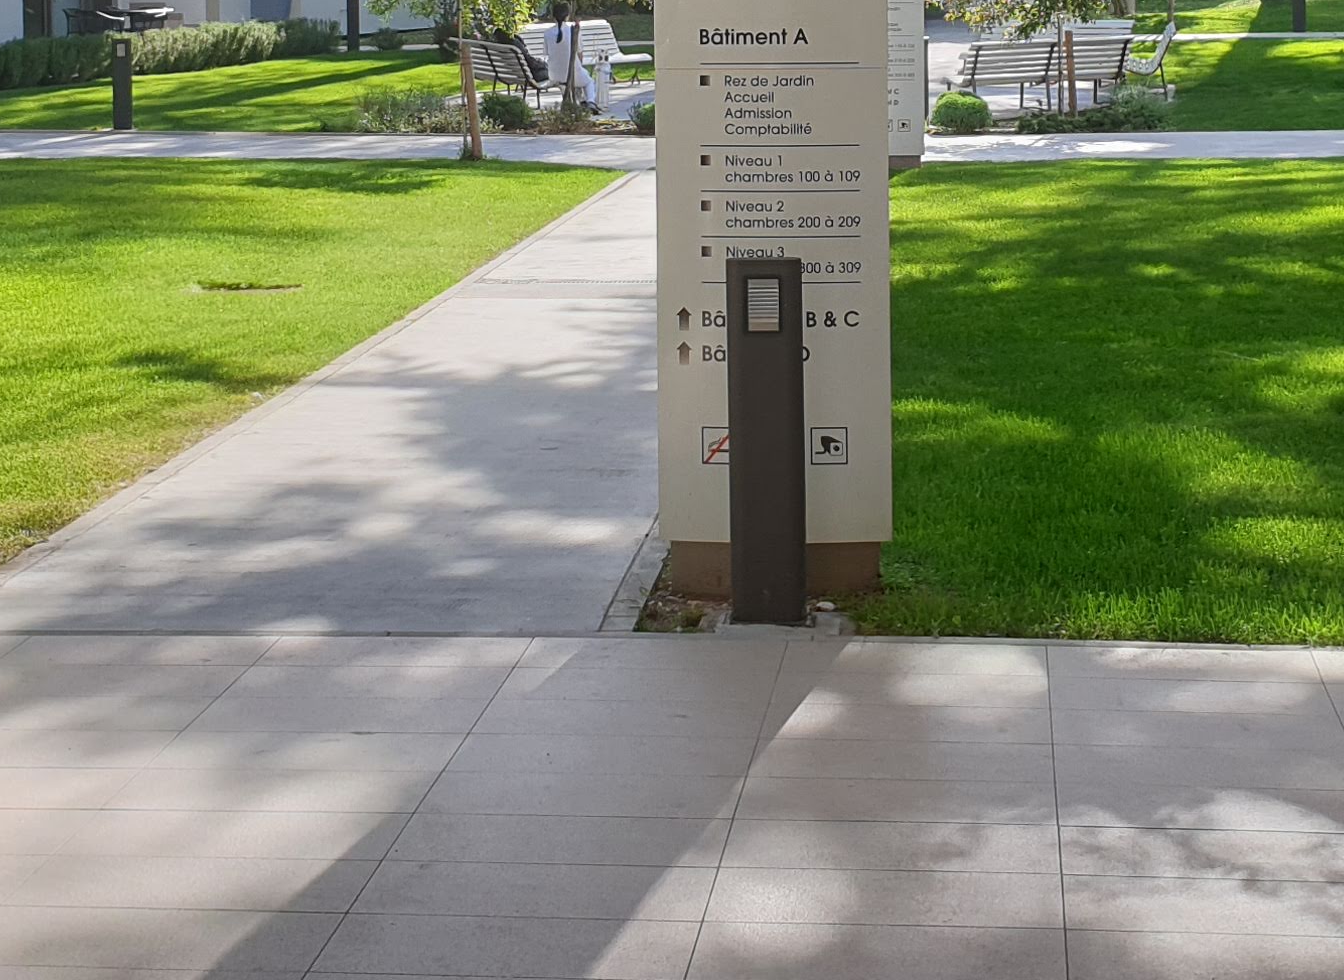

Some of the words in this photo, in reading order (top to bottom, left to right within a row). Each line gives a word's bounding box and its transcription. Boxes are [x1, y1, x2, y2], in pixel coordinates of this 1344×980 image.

[699, 27, 788, 46] Bâtiment
[793, 28, 809, 45] A
[725, 75, 747, 87] Rez
[750, 75, 769, 87] de
[772, 74, 815, 87] Jardin
[724, 91, 775, 103] Accueil
[724, 107, 793, 119] Admission
[724, 122, 812, 137] Comptabilité
[725, 155, 773, 167] Niveau
[777, 155, 782, 167] 1
[725, 171, 794, 183] chambres
[798, 171, 820, 182] 100
[824, 170, 834, 182] à
[838, 171, 861, 182] 109
[725, 201, 773, 213] Niveau
[776, 201, 785, 213] 2
[725, 217, 795, 229] chambres
[797, 217, 821, 229] 200
[824, 215, 834, 228] à
[838, 216, 861, 228] 209
[725, 246, 773, 257] Niveau
[776, 246, 785, 257] 3
[825, 261, 835, 274] à
[838, 261, 862, 274] 309
[806, 311, 818, 328] B
[823, 310, 838, 328] &
[843, 310, 860, 328] C
